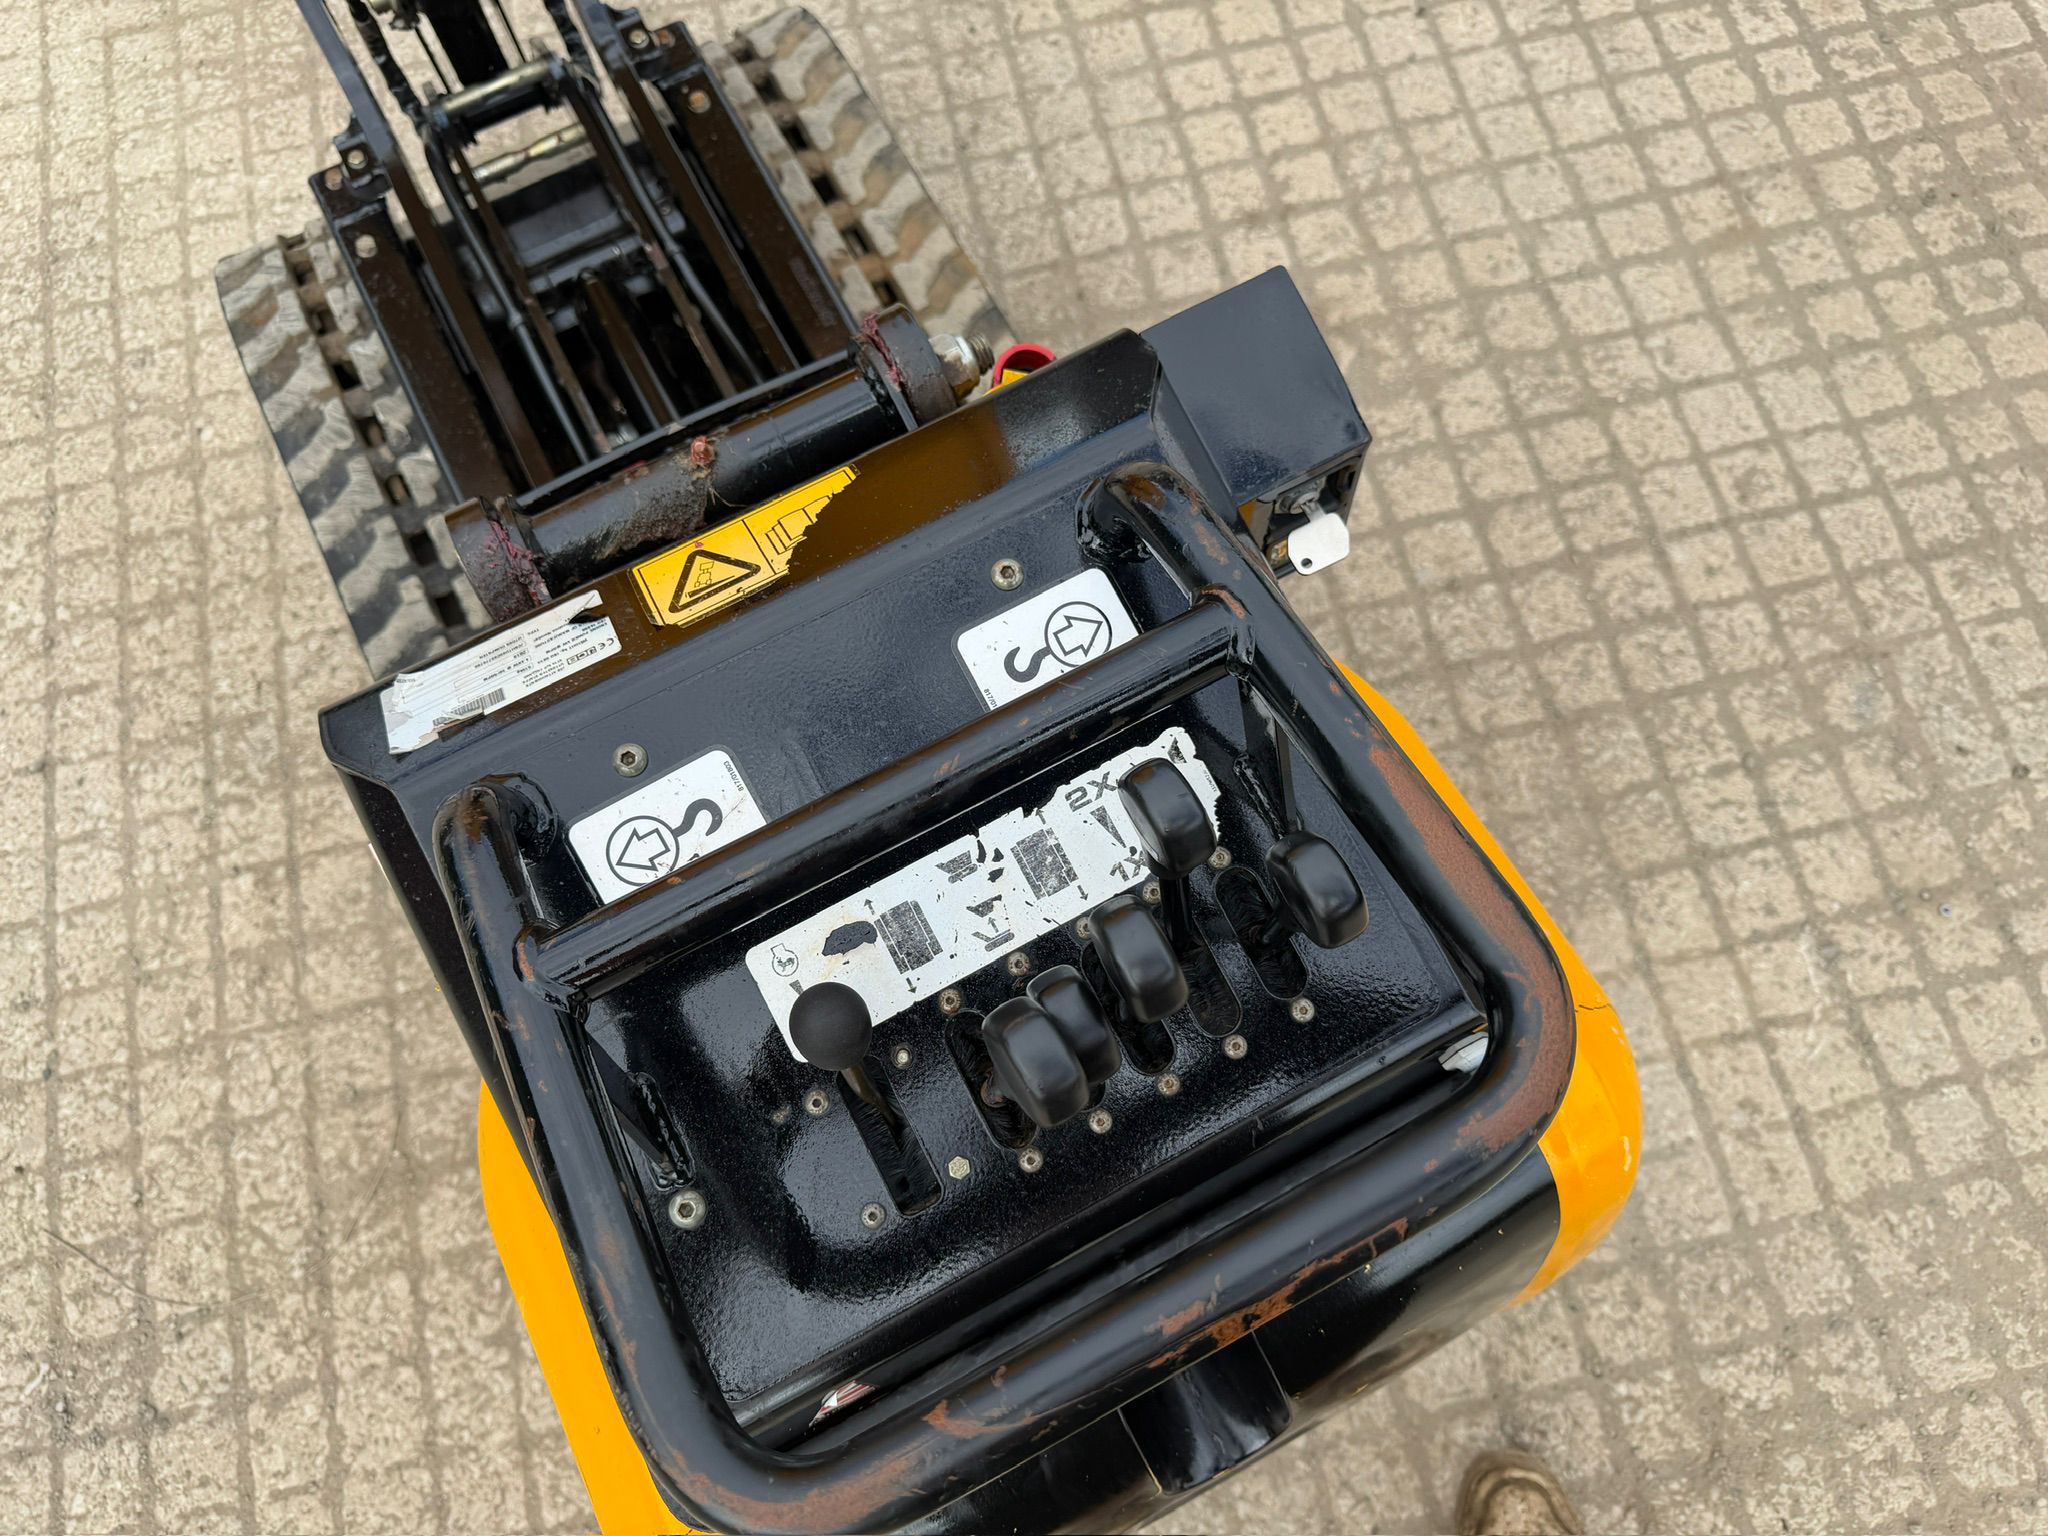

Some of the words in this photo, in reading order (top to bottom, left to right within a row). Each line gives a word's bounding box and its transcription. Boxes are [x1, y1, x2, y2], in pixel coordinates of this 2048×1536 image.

[566, 645, 598, 666] JCB
[723, 760, 745, 792] 817/01803
[1064, 770, 1119, 813] 2X
[1109, 850, 1147, 882] 1X
